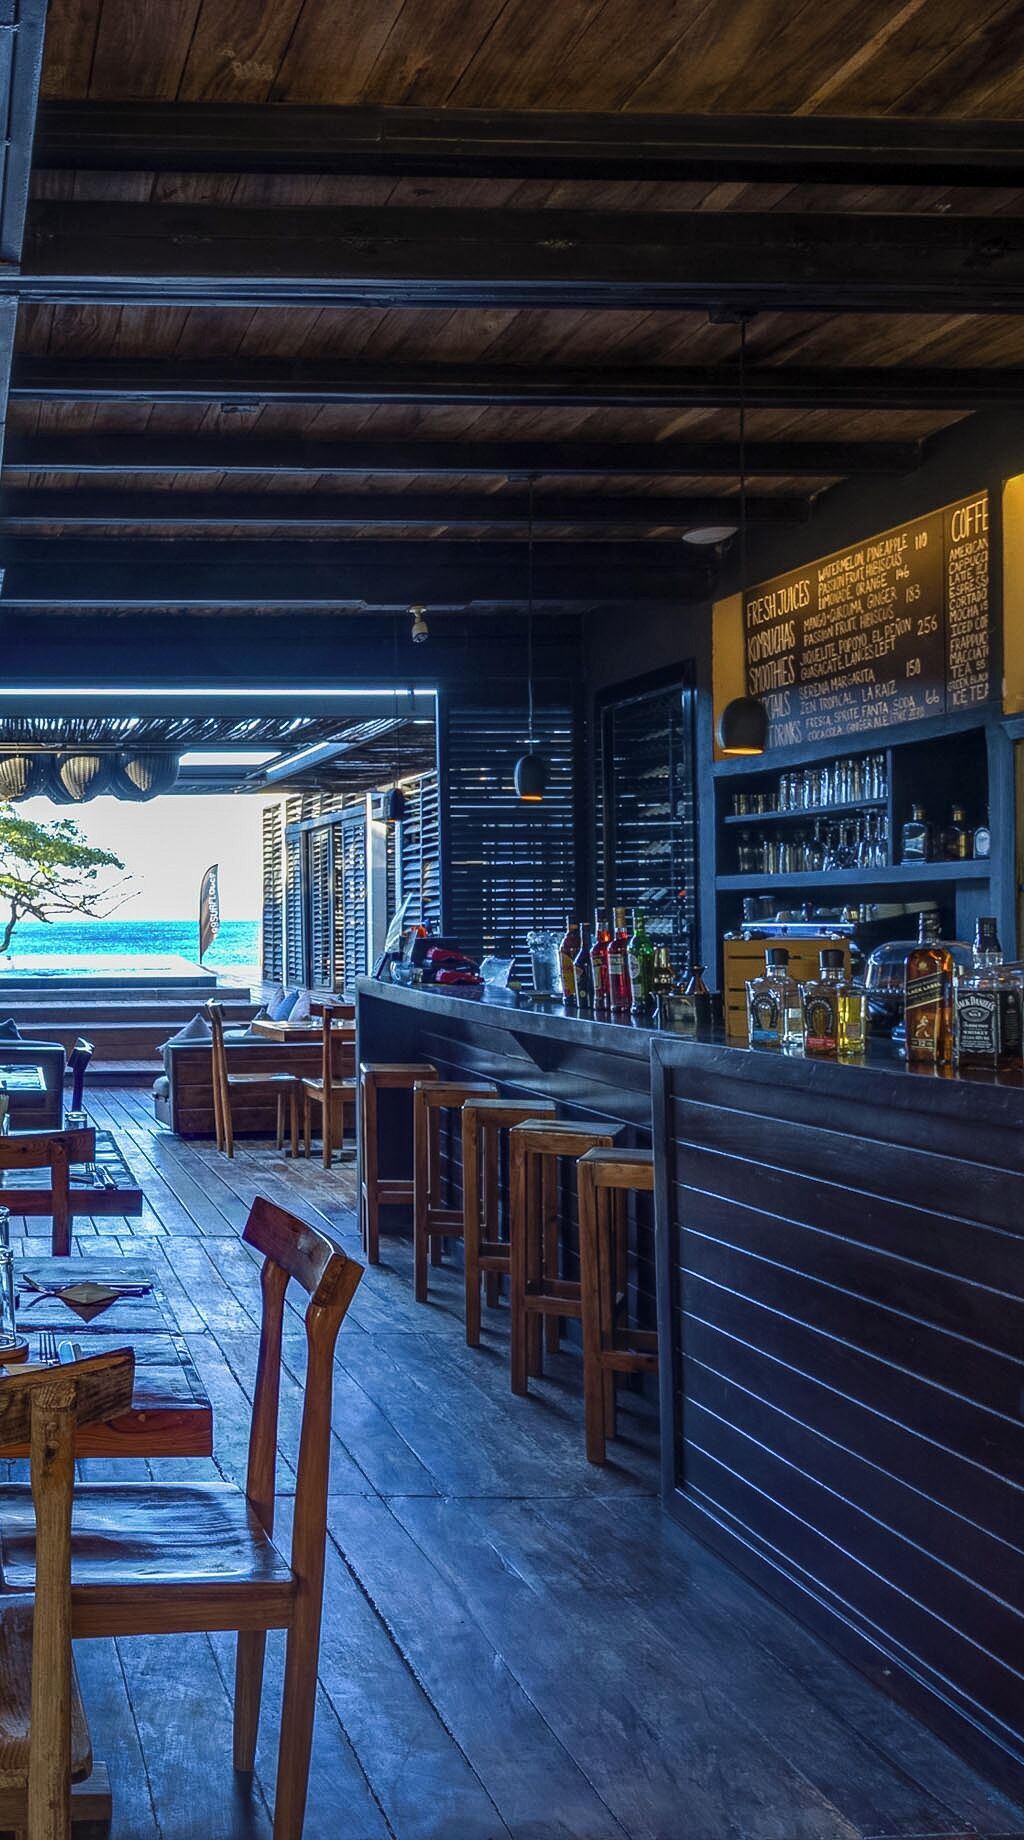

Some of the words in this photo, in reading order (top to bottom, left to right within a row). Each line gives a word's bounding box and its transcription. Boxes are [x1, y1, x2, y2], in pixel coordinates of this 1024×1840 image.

[951, 498, 989, 542] COFFE
[867, 533, 909, 562] PINEAPPLE
[949, 538, 989, 561] AMERICAN
[818, 574, 845, 596] PASSION
[865, 553, 903, 578] HIBISCUS
[855, 573, 888, 596] ORANGE
[949, 568, 975, 586] LATTE
[867, 587, 898, 608] GINGER
[906, 584, 921, 603] 183
[949, 576, 989, 598] ESPRESS
[746, 593, 777, 628] FRESH
[777, 580, 811, 615] JUICES
[949, 604, 979, 623] MOCHA
[803, 624, 834, 647] PASSION
[859, 604, 895, 629] HIBISCUS
[872, 631, 884, 643] EL
[917, 614, 938, 636] 256
[950, 621, 974, 637] ICED
[747, 620, 796, 664] KOMBUCHAS
[875, 638, 897, 657] LEFT
[950, 632, 989, 651] FRAPPUC
[748, 655, 796, 695] SMOOTHIES
[830, 669, 876, 690] MARGARITA
[906, 658, 921, 677] 150
[950, 662, 973, 678] TEA
[861, 702, 889, 717] FANTA
[925, 688, 940, 704] 66
[862, 686, 874, 701] LA
[952, 688, 968, 704] ICE
[907, 987, 922, 996] LACK
